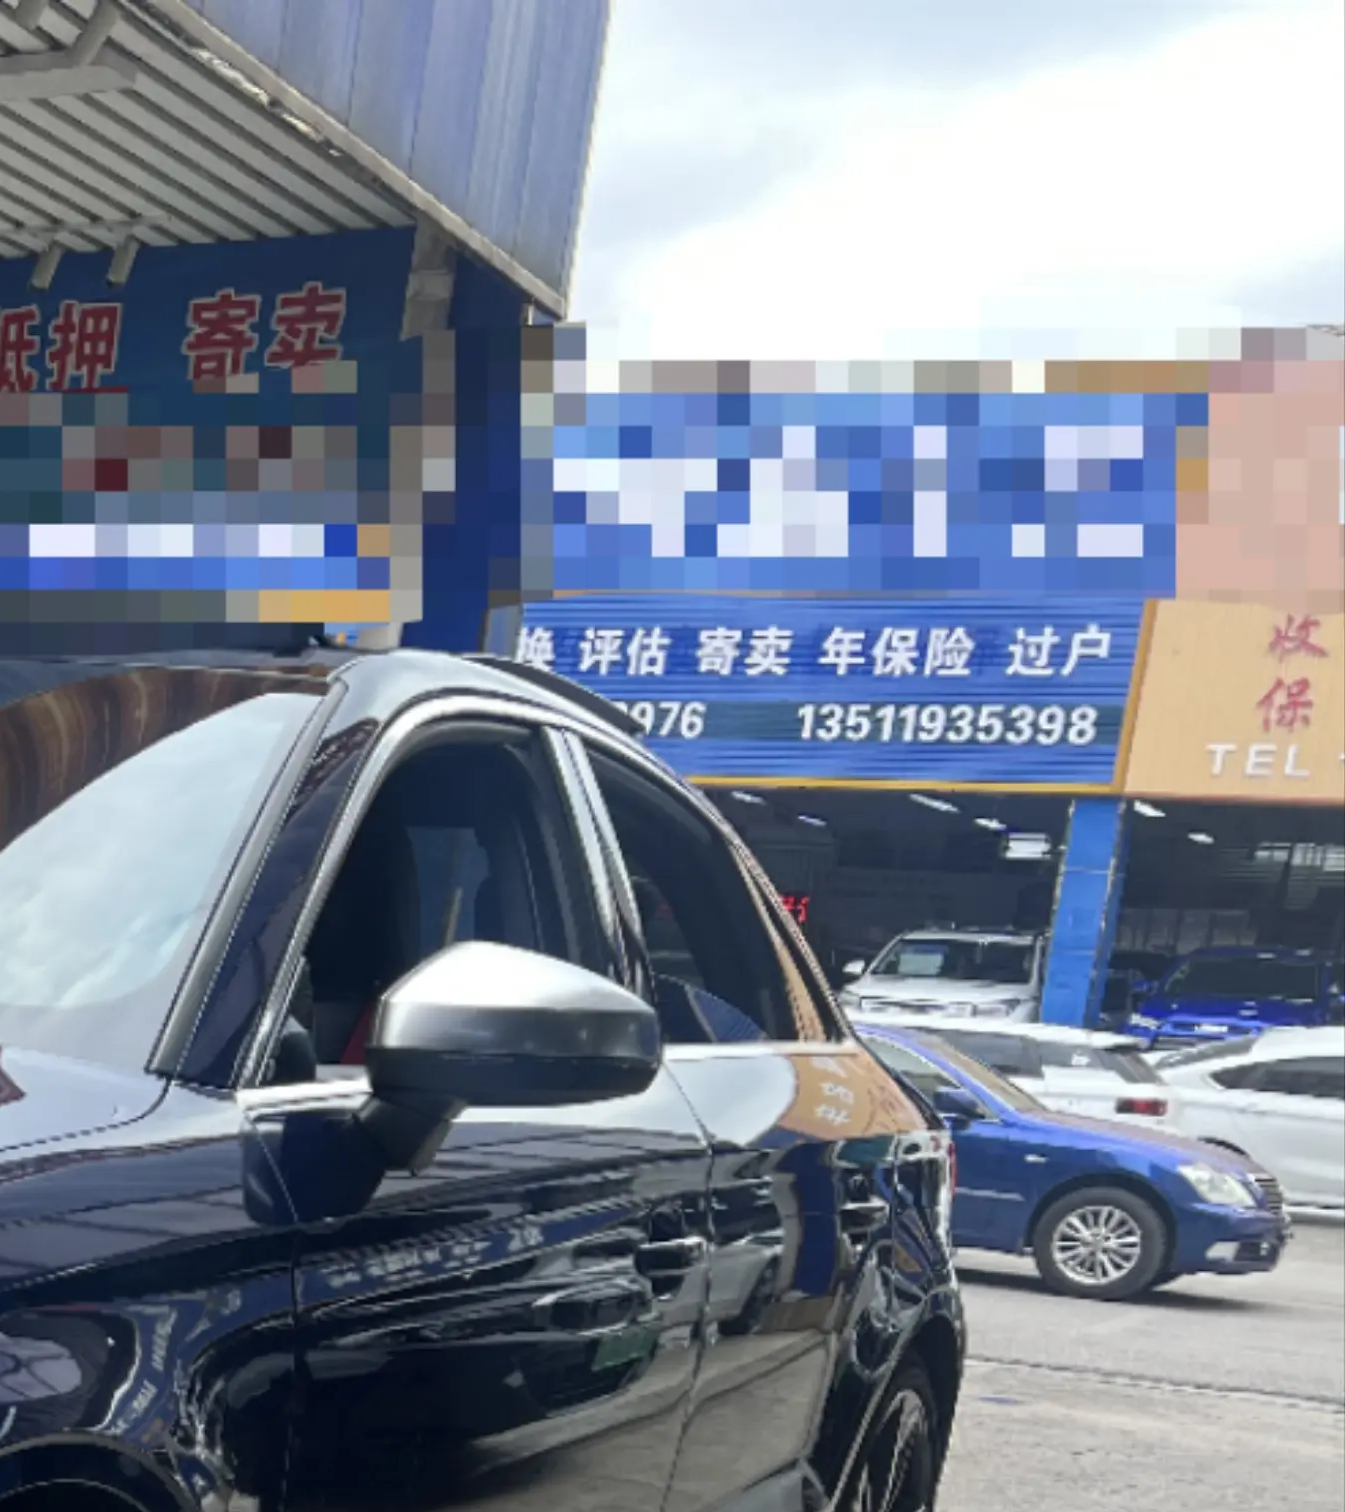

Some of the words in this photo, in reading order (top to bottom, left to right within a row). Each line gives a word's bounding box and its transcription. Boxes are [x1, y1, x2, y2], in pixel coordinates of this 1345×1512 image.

[182, 282, 346, 380] 寄卖
[578, 626, 671, 676] 评估
[697, 625, 793, 676] 寄卖
[819, 625, 976, 677] 年保险
[1006, 621, 1112, 677] 过户
[610, 701, 706, 738] 976
[798, 703, 1098, 745] 13511935398
[1257, 677, 1314, 733] 保
[1206, 743, 1311, 779] TEL
